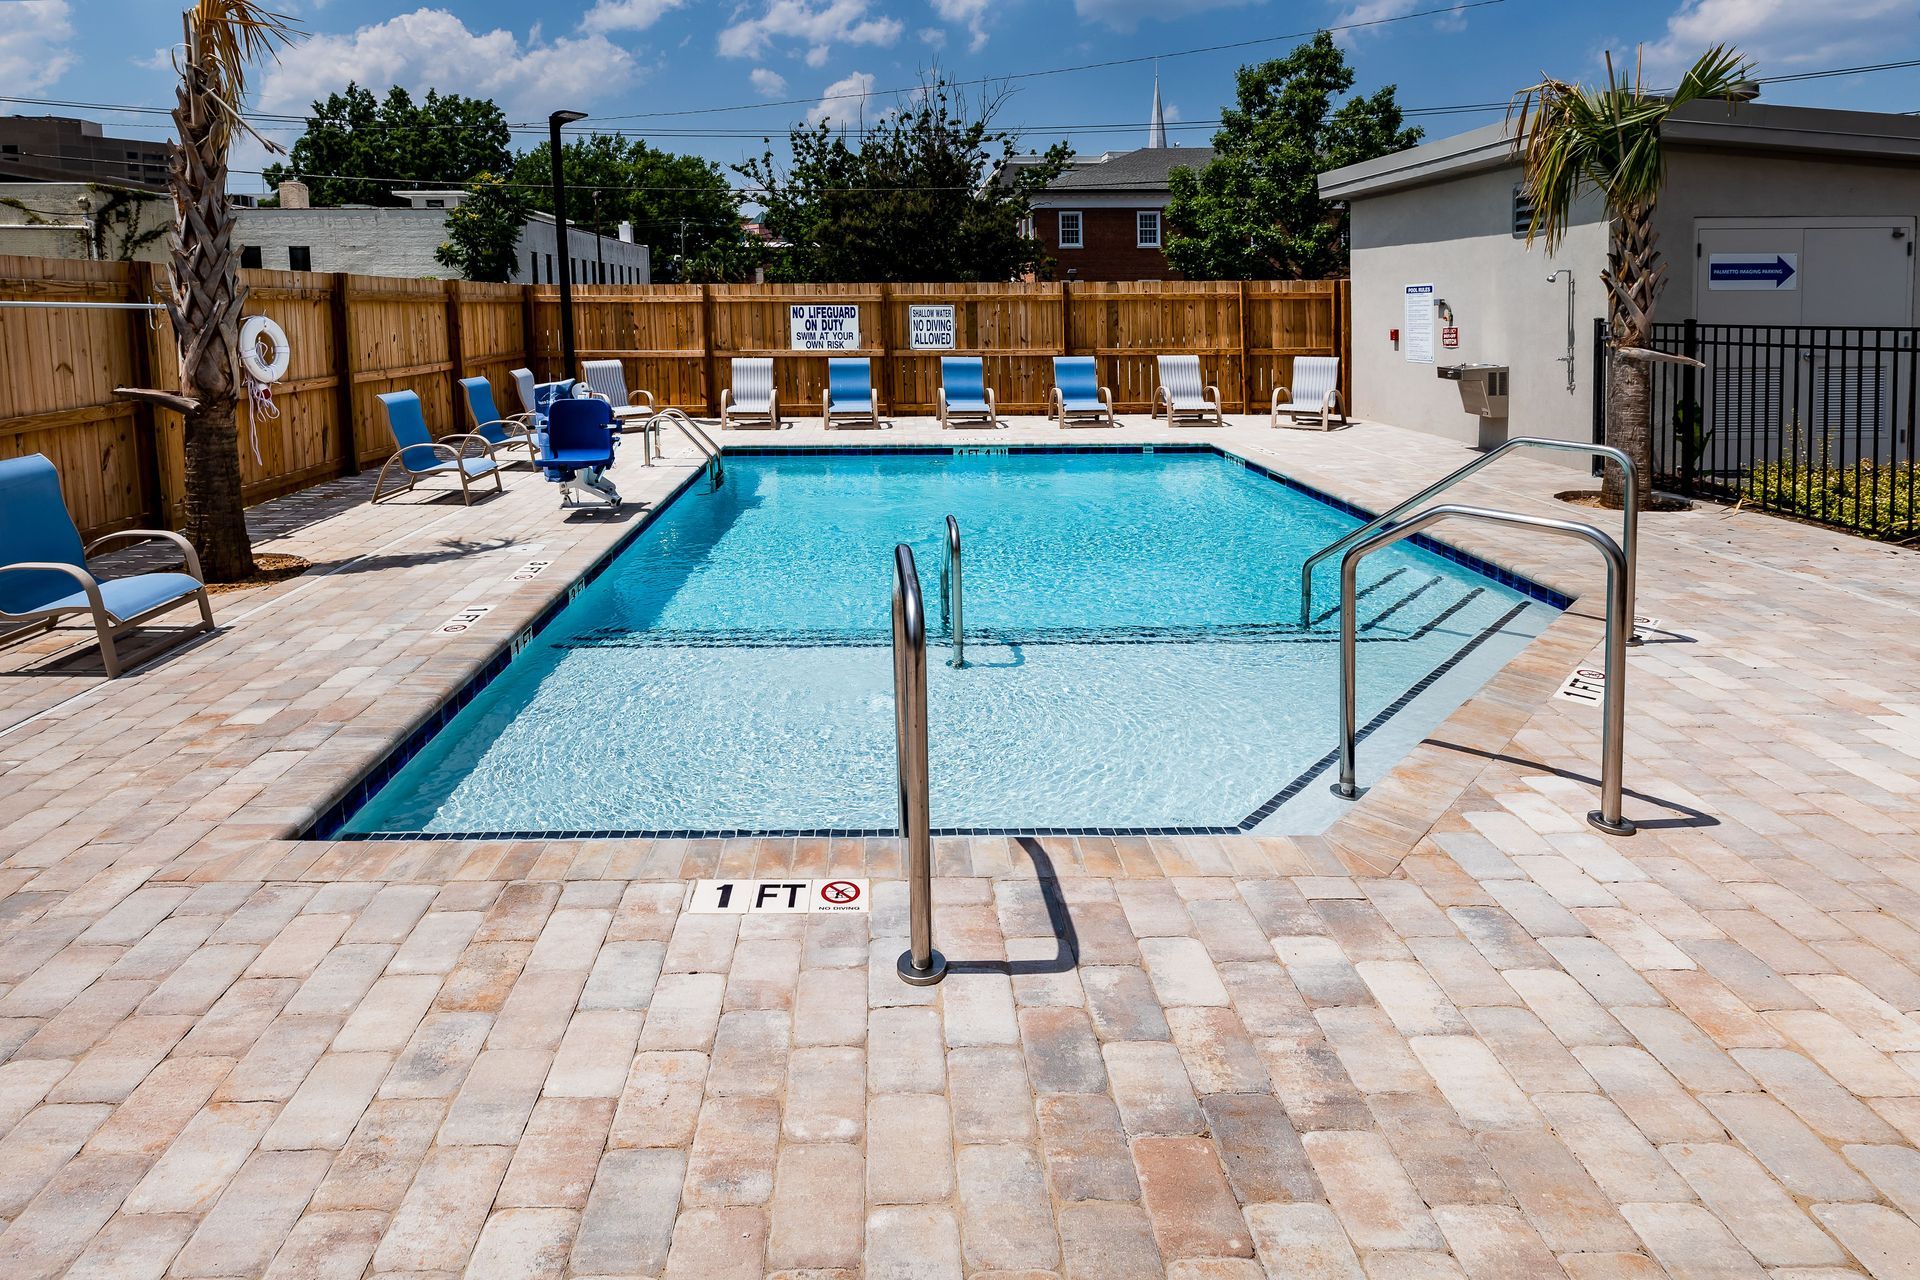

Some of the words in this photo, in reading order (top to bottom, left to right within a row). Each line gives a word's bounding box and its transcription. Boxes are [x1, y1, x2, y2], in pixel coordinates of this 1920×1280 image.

[792, 306, 805, 319] NO
[808, 306, 856, 319] LIFEGUARD
[912, 309, 935, 318] SHALLOW
[935, 309, 952, 318] WATER
[805, 319, 817, 331] ON
[822, 319, 844, 331] DUTY
[913, 320, 924, 331] NO
[926, 320, 952, 332] DIVING
[796, 332, 816, 341] SWIM
[820, 332, 829, 341] AT
[833, 332, 854, 341] YOUR
[914, 333, 951, 345] ALLOWED
[806, 341, 825, 349] OWN
[827, 341, 845, 349] RISK
[451, 614, 480, 623] FT
[515, 639, 520, 654] 1
[522, 628, 532, 647] FT
[1569, 678, 1605, 694] FT
[1563, 691, 1597, 701] 1
[716, 884, 734, 908] 1
[755, 884, 806, 908] FT
